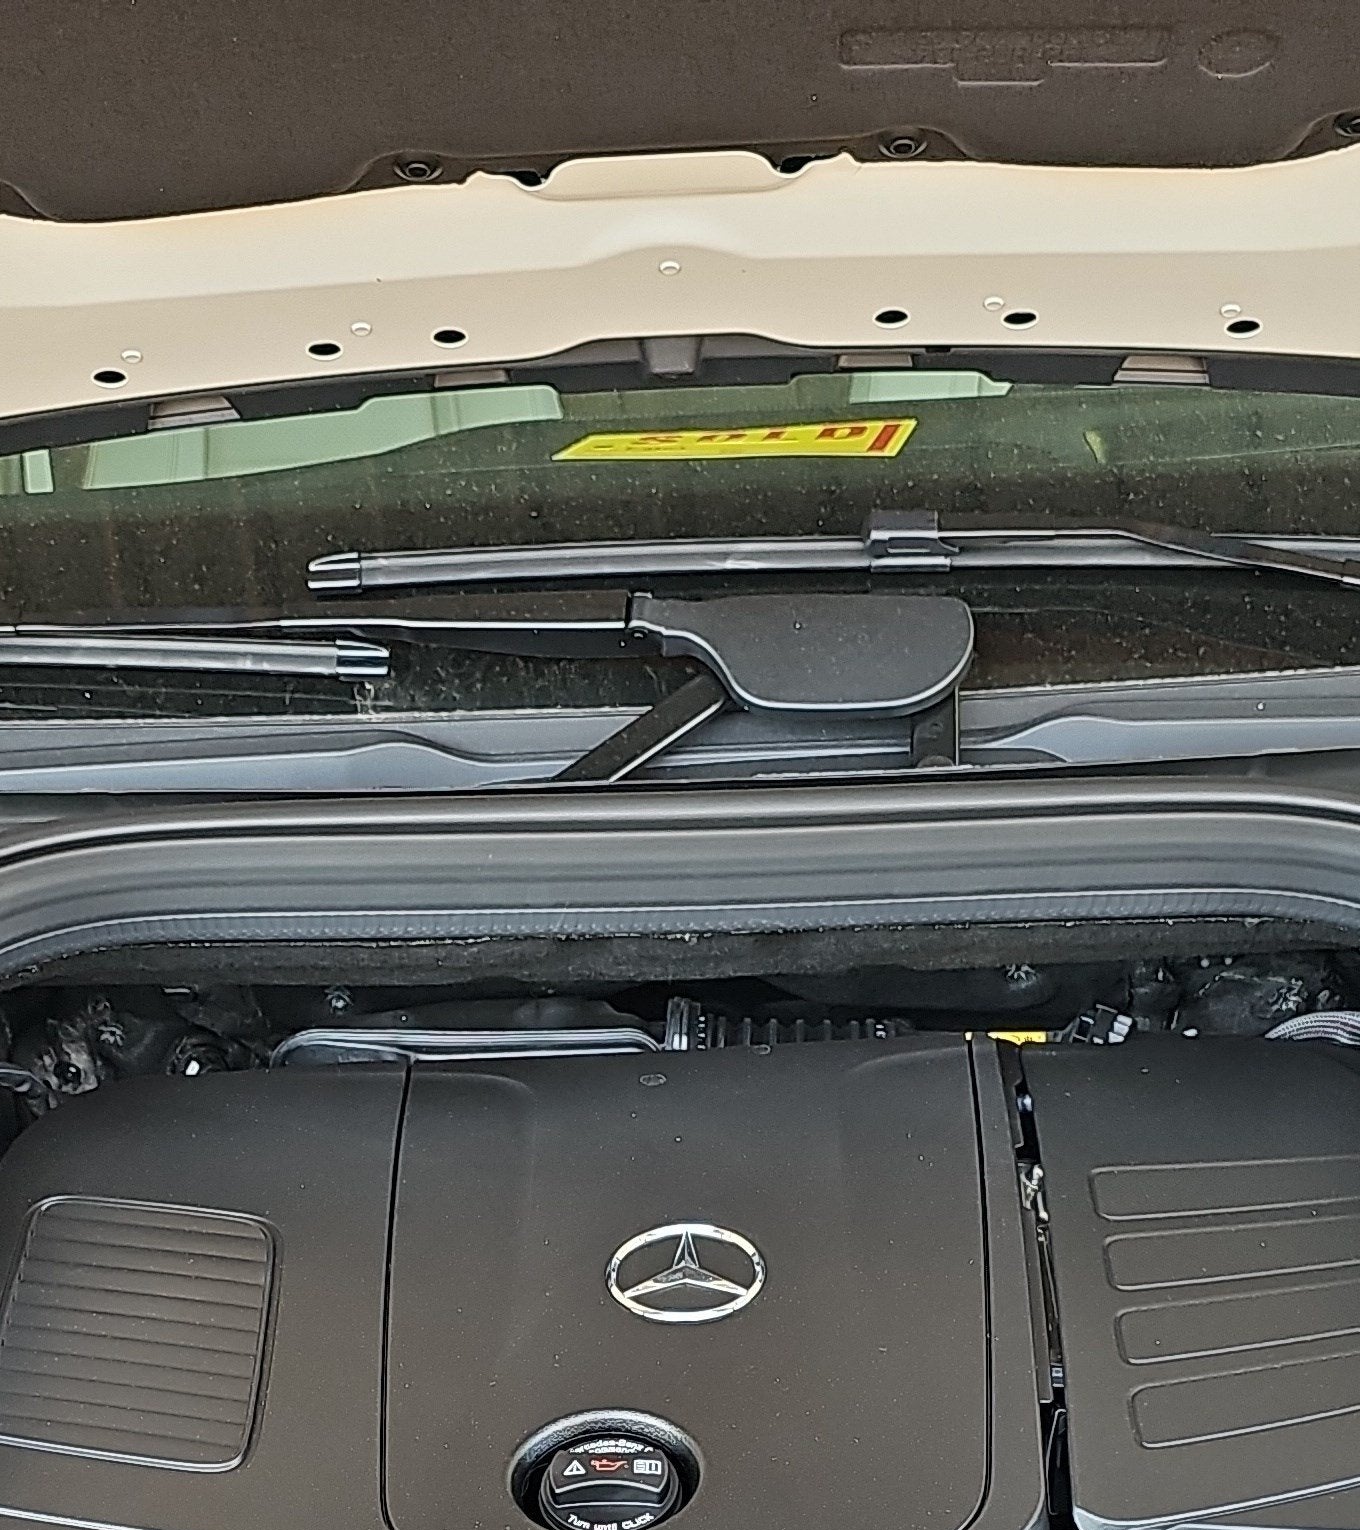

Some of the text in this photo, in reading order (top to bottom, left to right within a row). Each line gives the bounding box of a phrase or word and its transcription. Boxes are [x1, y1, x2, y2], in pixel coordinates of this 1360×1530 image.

[567, 1512, 655, 1530] Turn until CLICK
